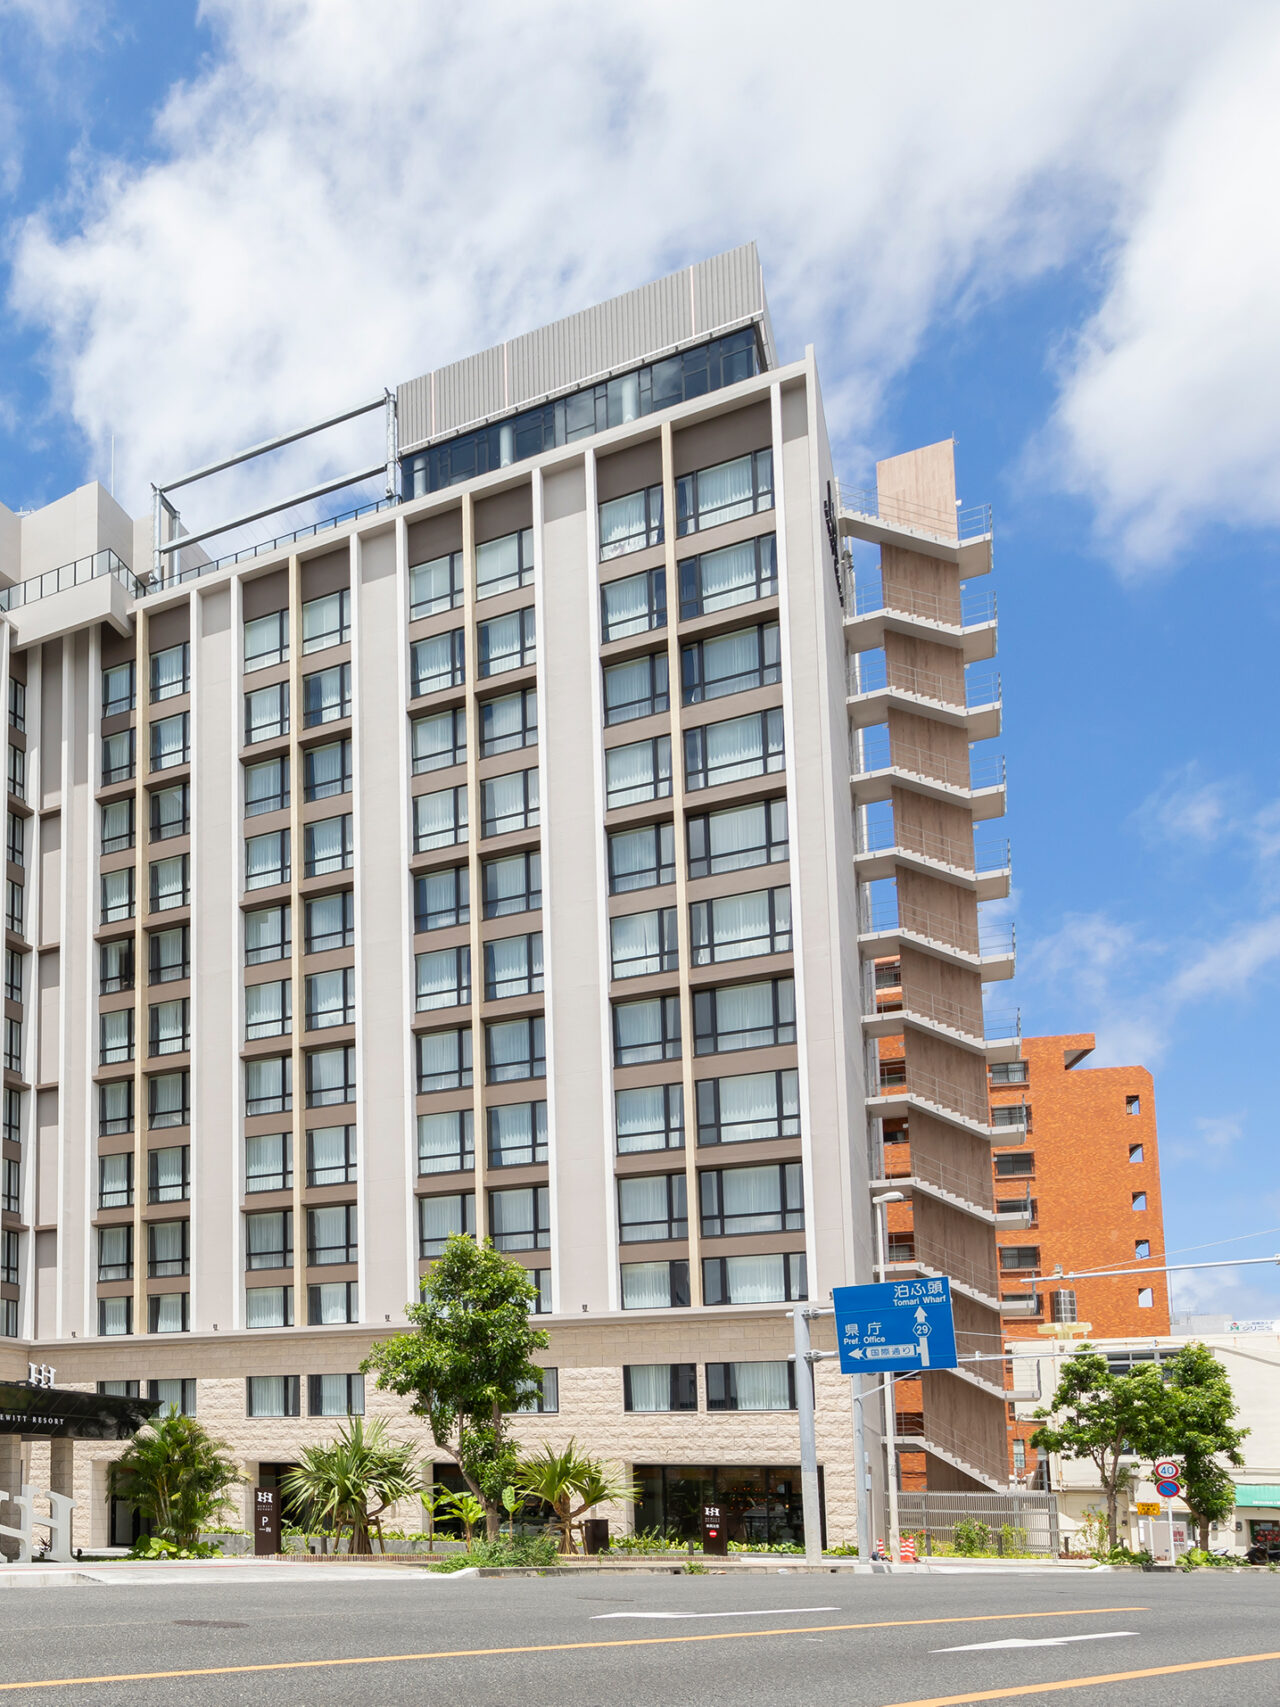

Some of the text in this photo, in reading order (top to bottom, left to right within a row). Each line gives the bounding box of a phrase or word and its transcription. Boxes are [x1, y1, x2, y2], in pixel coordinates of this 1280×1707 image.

[893, 1280, 943, 1298] 泊ふ頭
[892, 1294, 947, 1307] Tomari Wharf
[844, 1321, 883, 1337] 県庁
[916, 1325, 929, 1334] 29
[843, 1335, 886, 1345] Pref. Office
[870, 1346, 912, 1356] 国際通り
[32, 1416, 64, 1425] RESORT
[1160, 1465, 1174, 1476] 40
[262, 1516, 269, 1526] P
